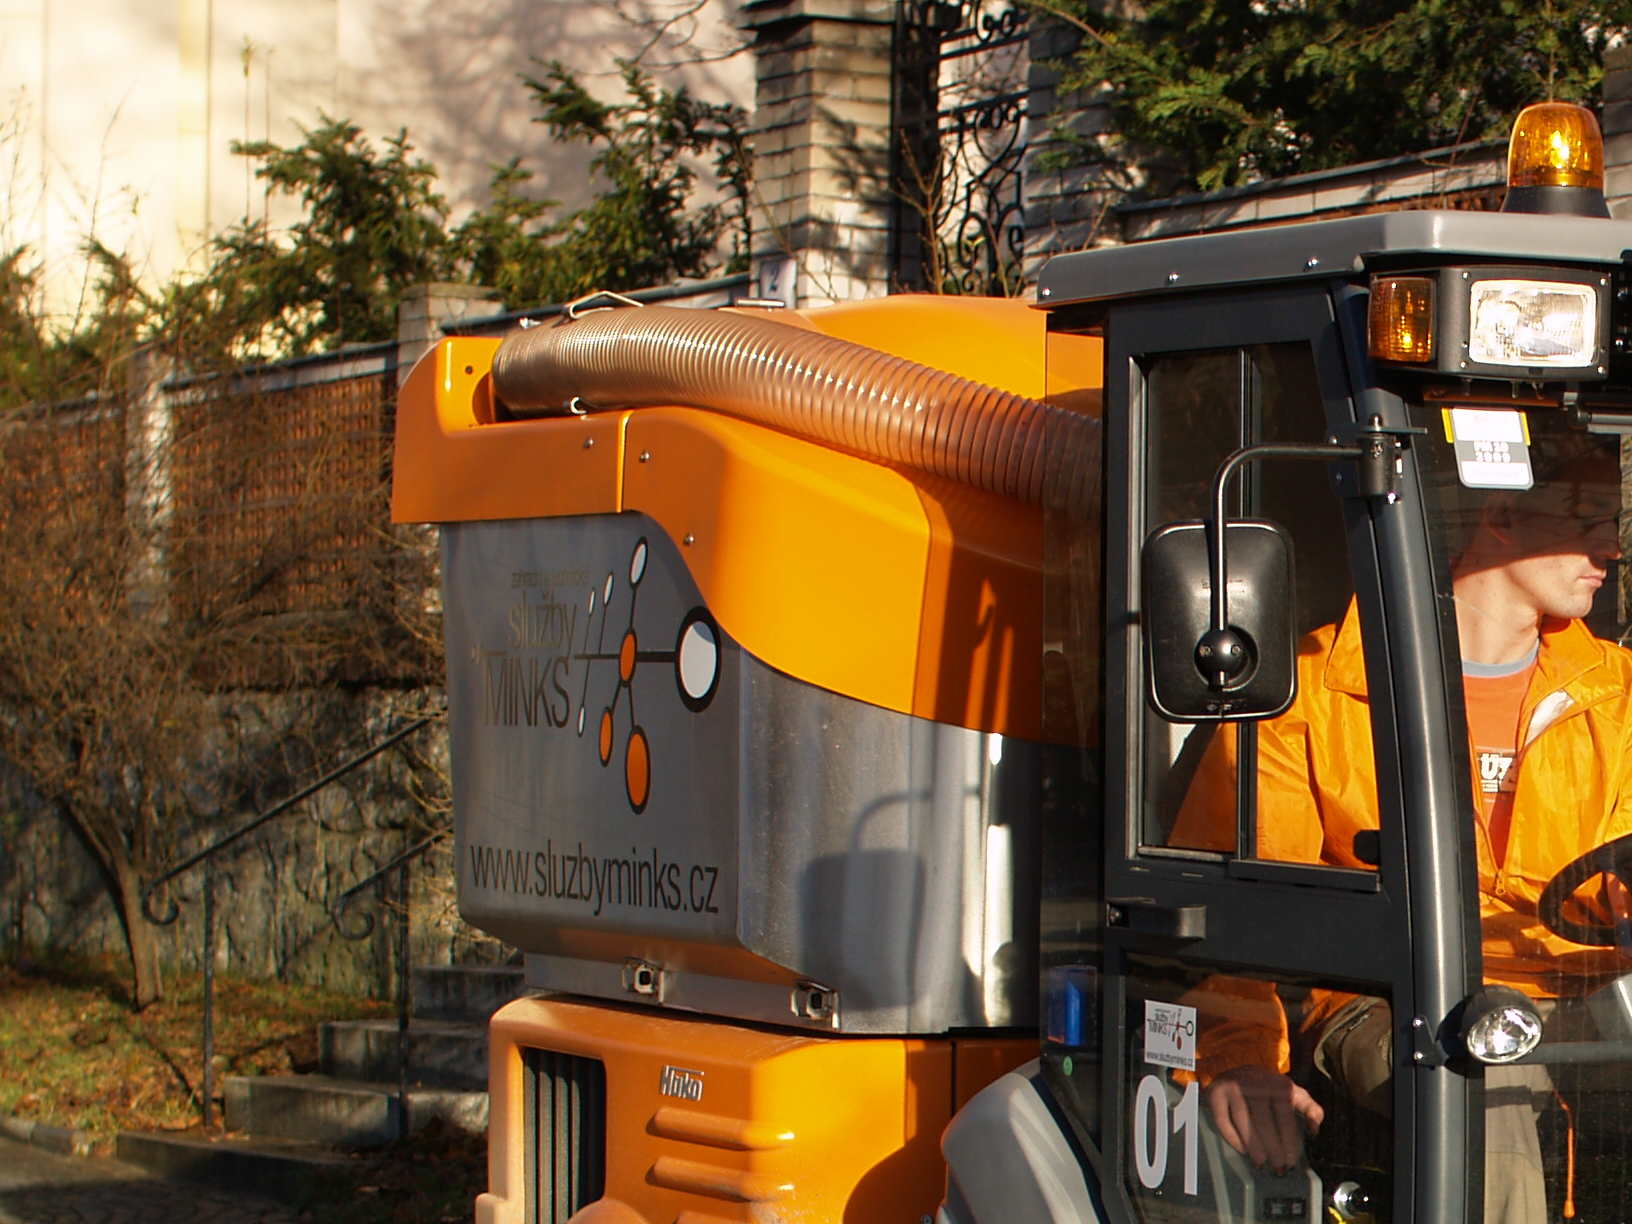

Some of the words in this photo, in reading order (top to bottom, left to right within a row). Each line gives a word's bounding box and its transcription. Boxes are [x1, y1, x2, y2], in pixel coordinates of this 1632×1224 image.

[509, 589, 577, 658] služby
[483, 656, 571, 728] MINKS
[470, 839, 720, 917] www.sluzbyminks.cz
[659, 1065, 705, 1102] Hako
[1134, 1074, 1199, 1196] 01
